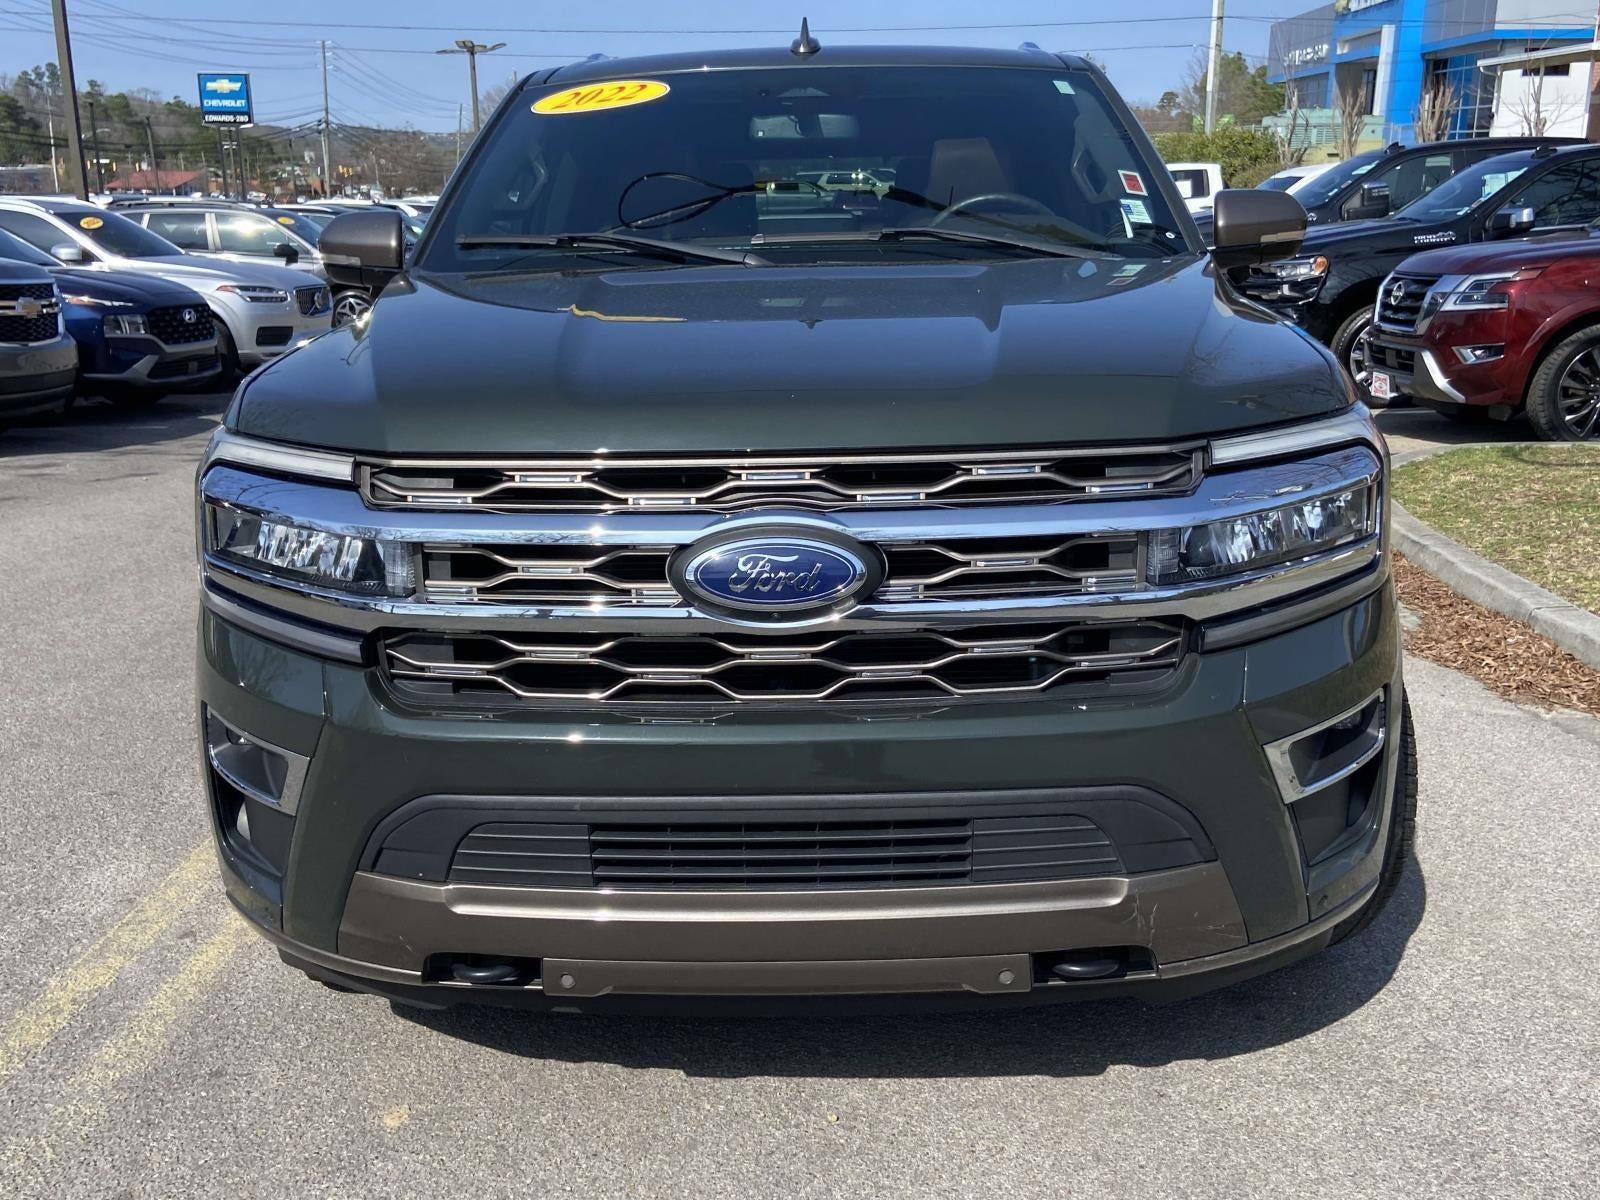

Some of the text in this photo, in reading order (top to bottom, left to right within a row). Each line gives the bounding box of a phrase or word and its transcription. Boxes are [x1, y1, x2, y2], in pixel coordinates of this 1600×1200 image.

[203, 99, 246, 107] CHEVROLET
[550, 84, 647, 110] 2022
[728, 553, 823, 593] Ford
